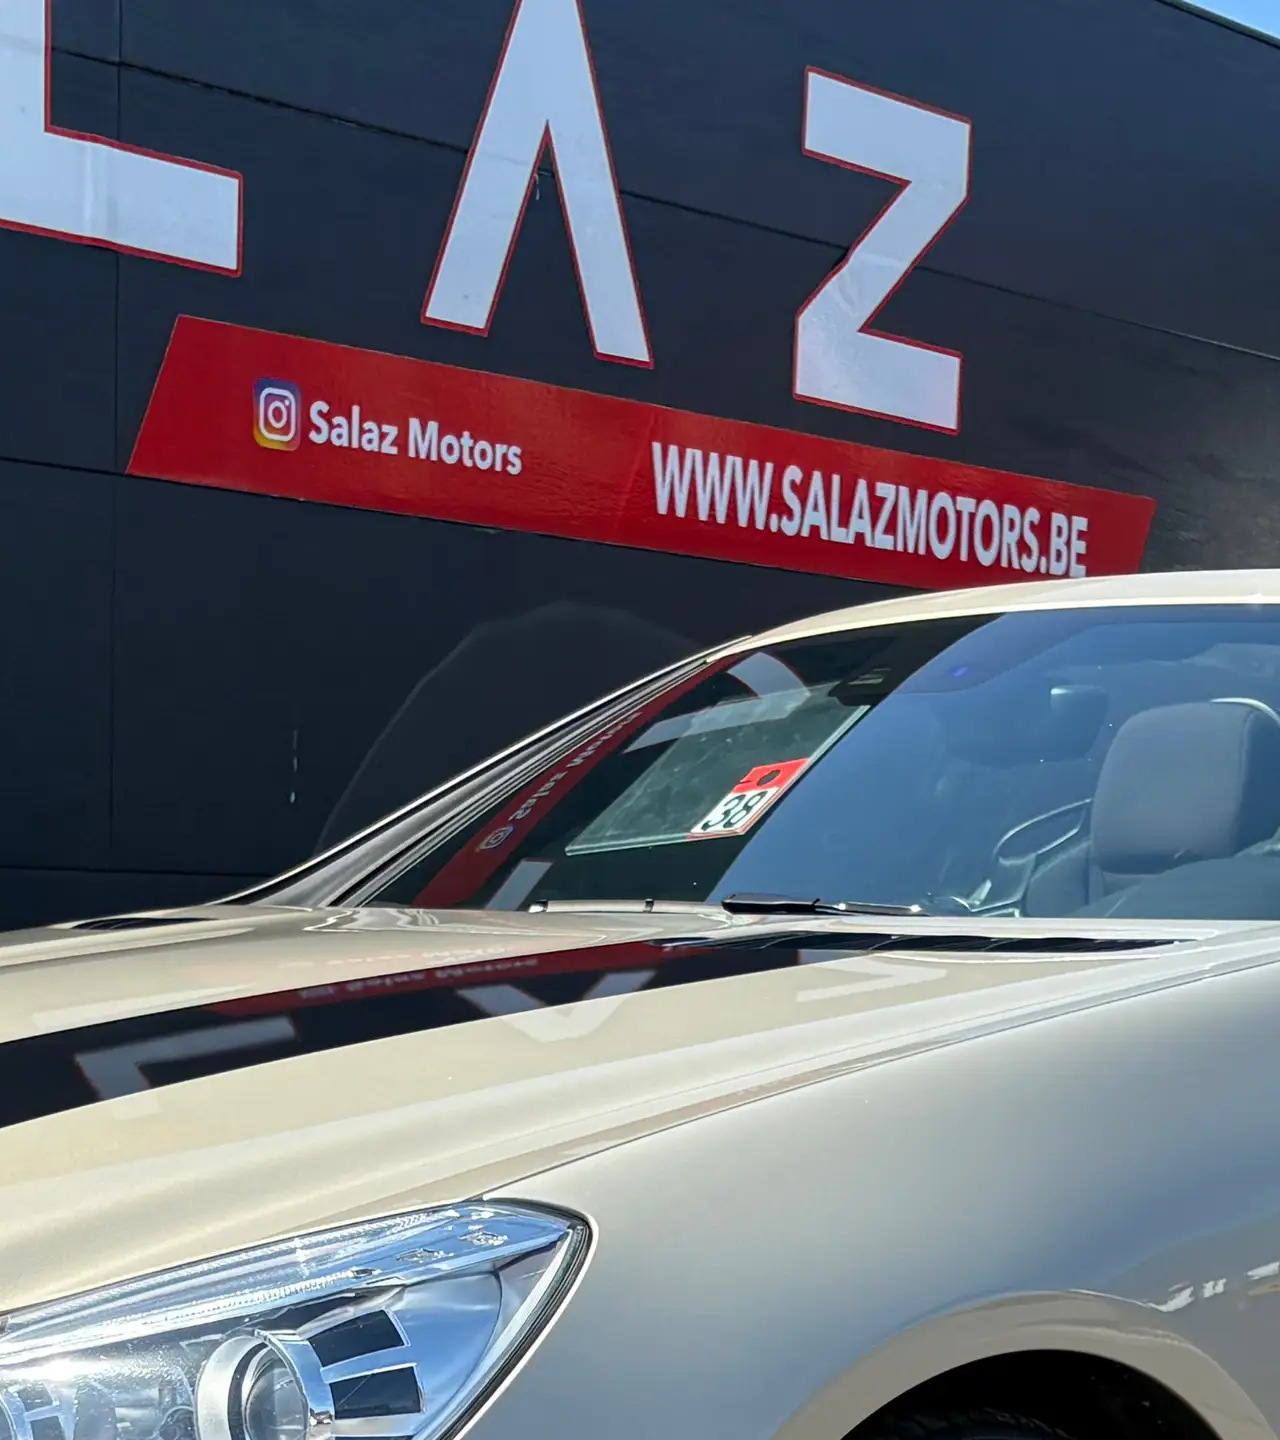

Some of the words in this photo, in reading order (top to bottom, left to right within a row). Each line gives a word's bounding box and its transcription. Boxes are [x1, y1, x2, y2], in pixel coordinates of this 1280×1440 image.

[308, 399, 399, 455] Salaz
[408, 417, 522, 476] Motors
[651, 441, 1089, 578] WWW.SALAZMOTORS.BE
[700, 789, 769, 832] 38
